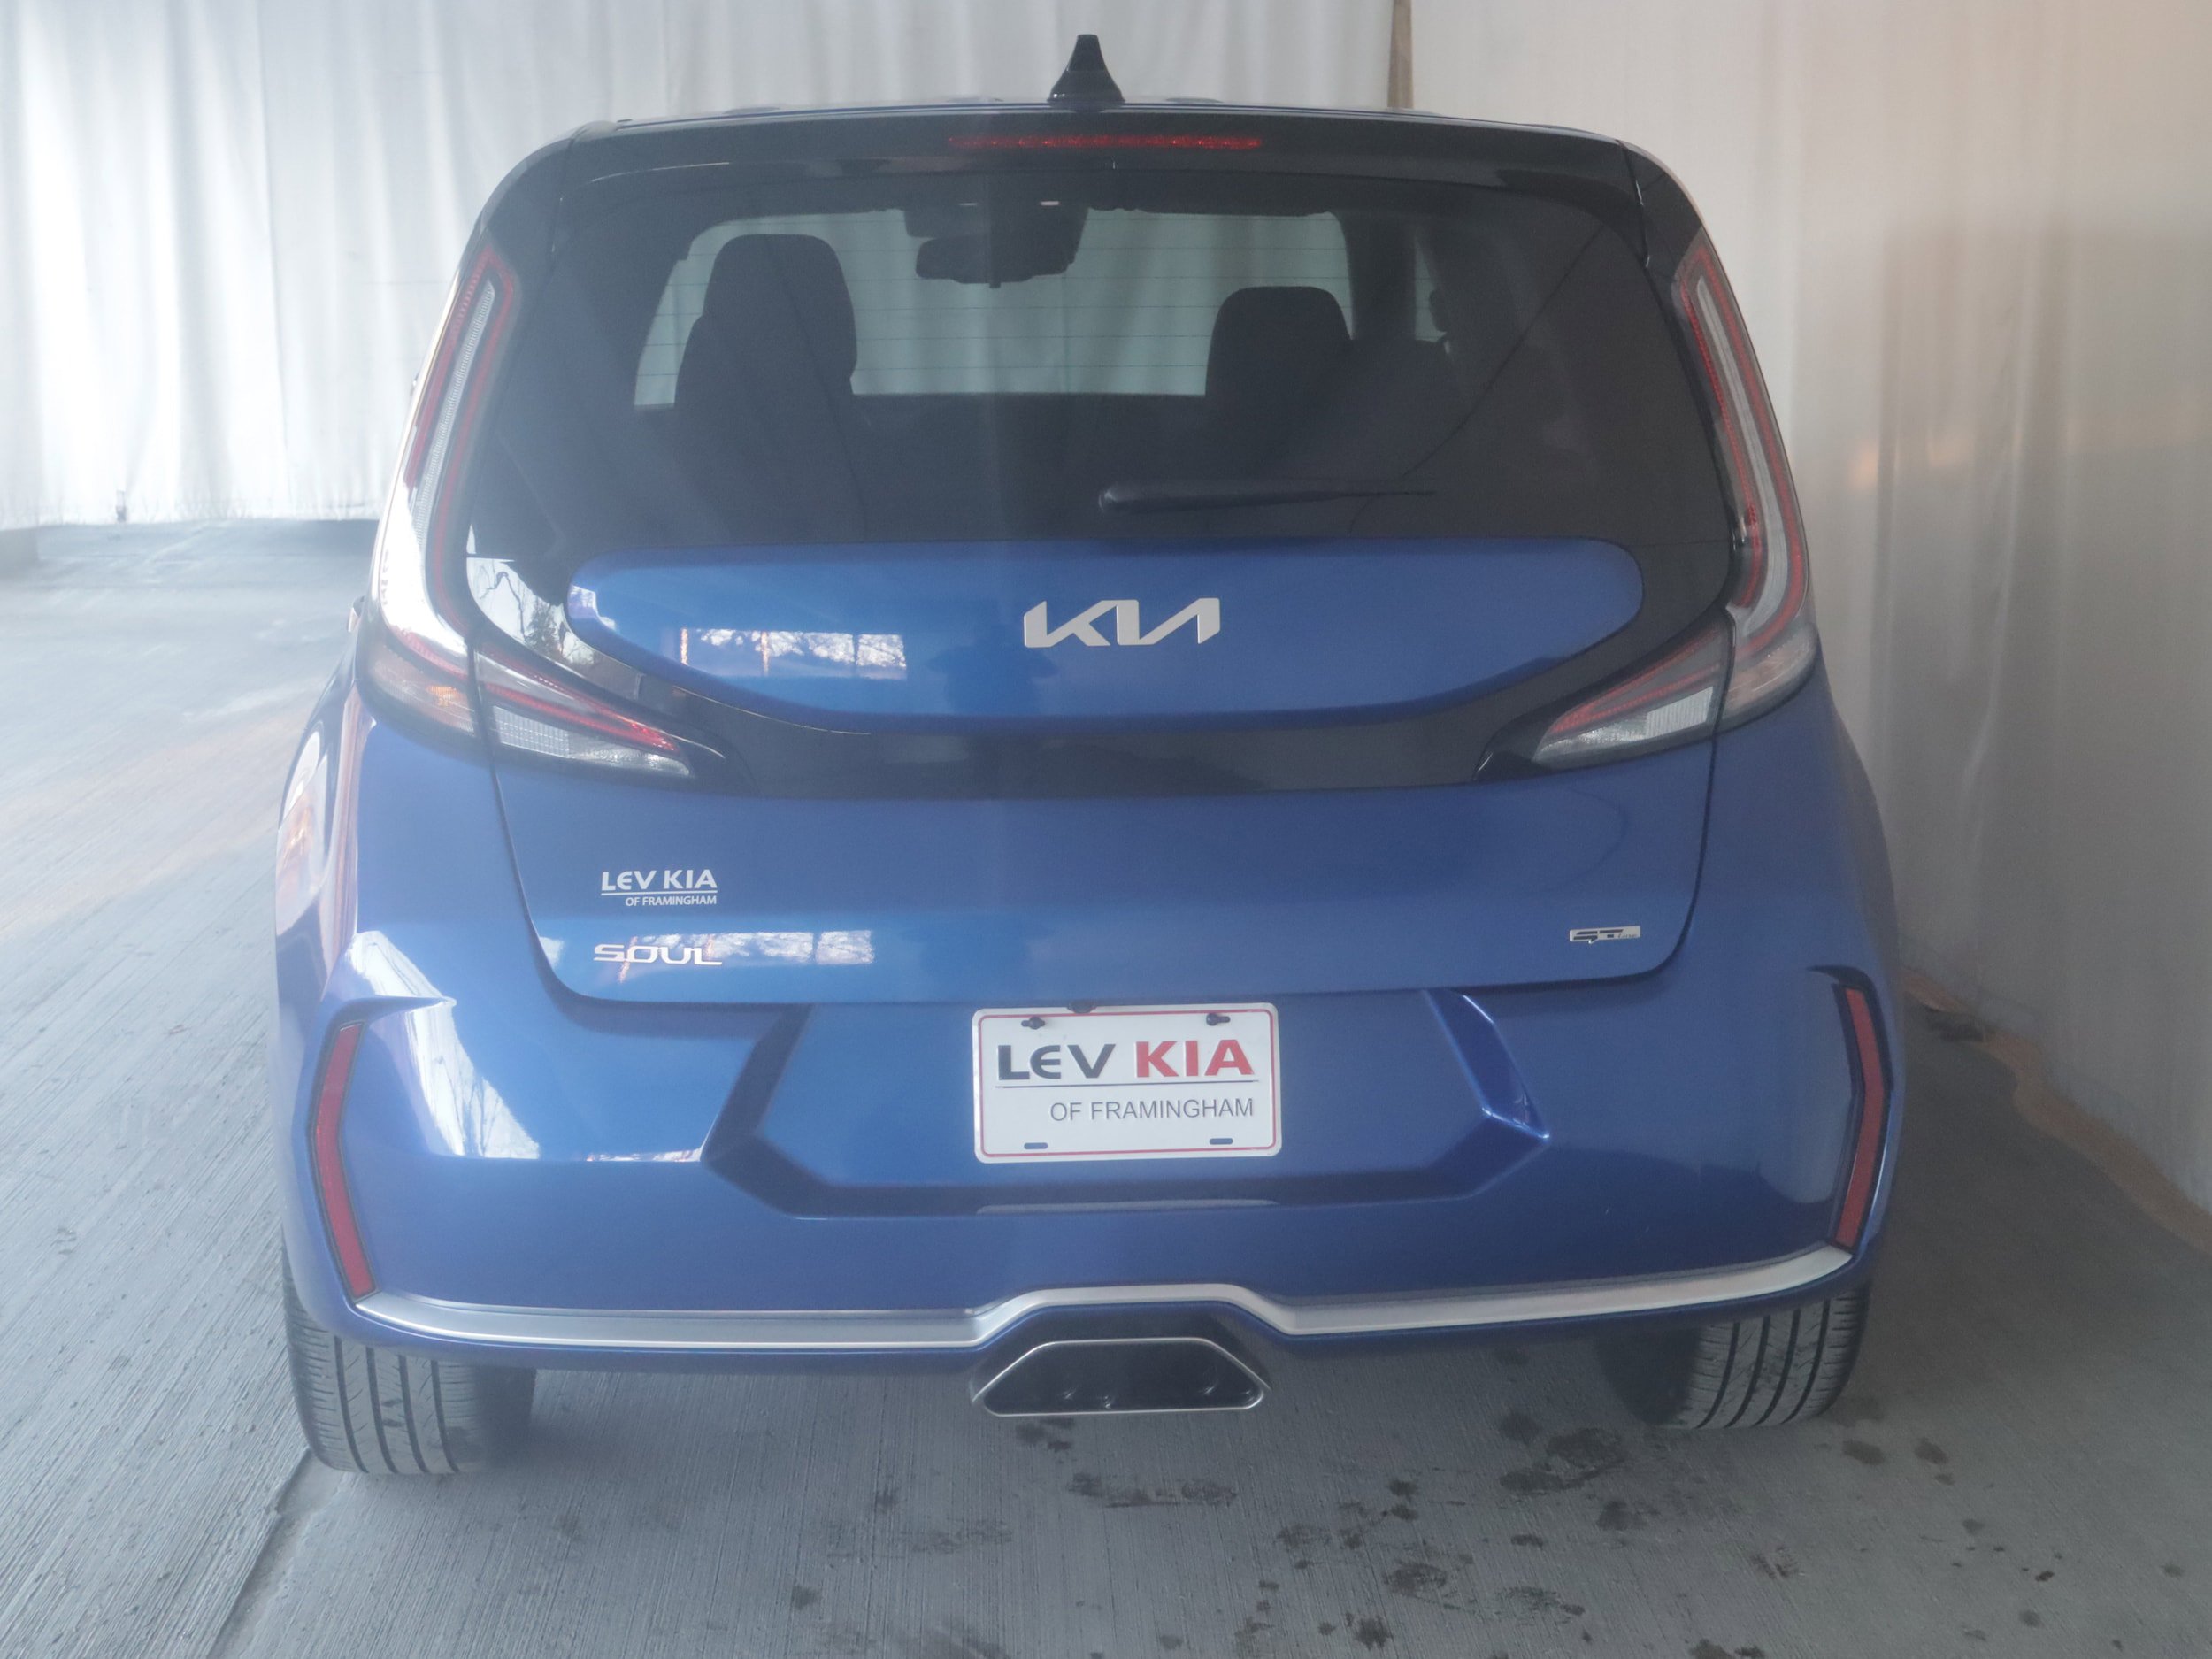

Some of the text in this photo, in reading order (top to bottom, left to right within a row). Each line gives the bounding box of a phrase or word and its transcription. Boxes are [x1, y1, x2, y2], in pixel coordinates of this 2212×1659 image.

[1024, 597, 1221, 648] KIA
[601, 869, 718, 892] LEV KIA
[626, 895, 718, 907] OF FRAMINGHAM
[593, 943, 723, 966] SOUL
[997, 1039, 1255, 1080] LEV KIA
[1049, 1097, 1254, 1122] OF FRAMINGHAM
